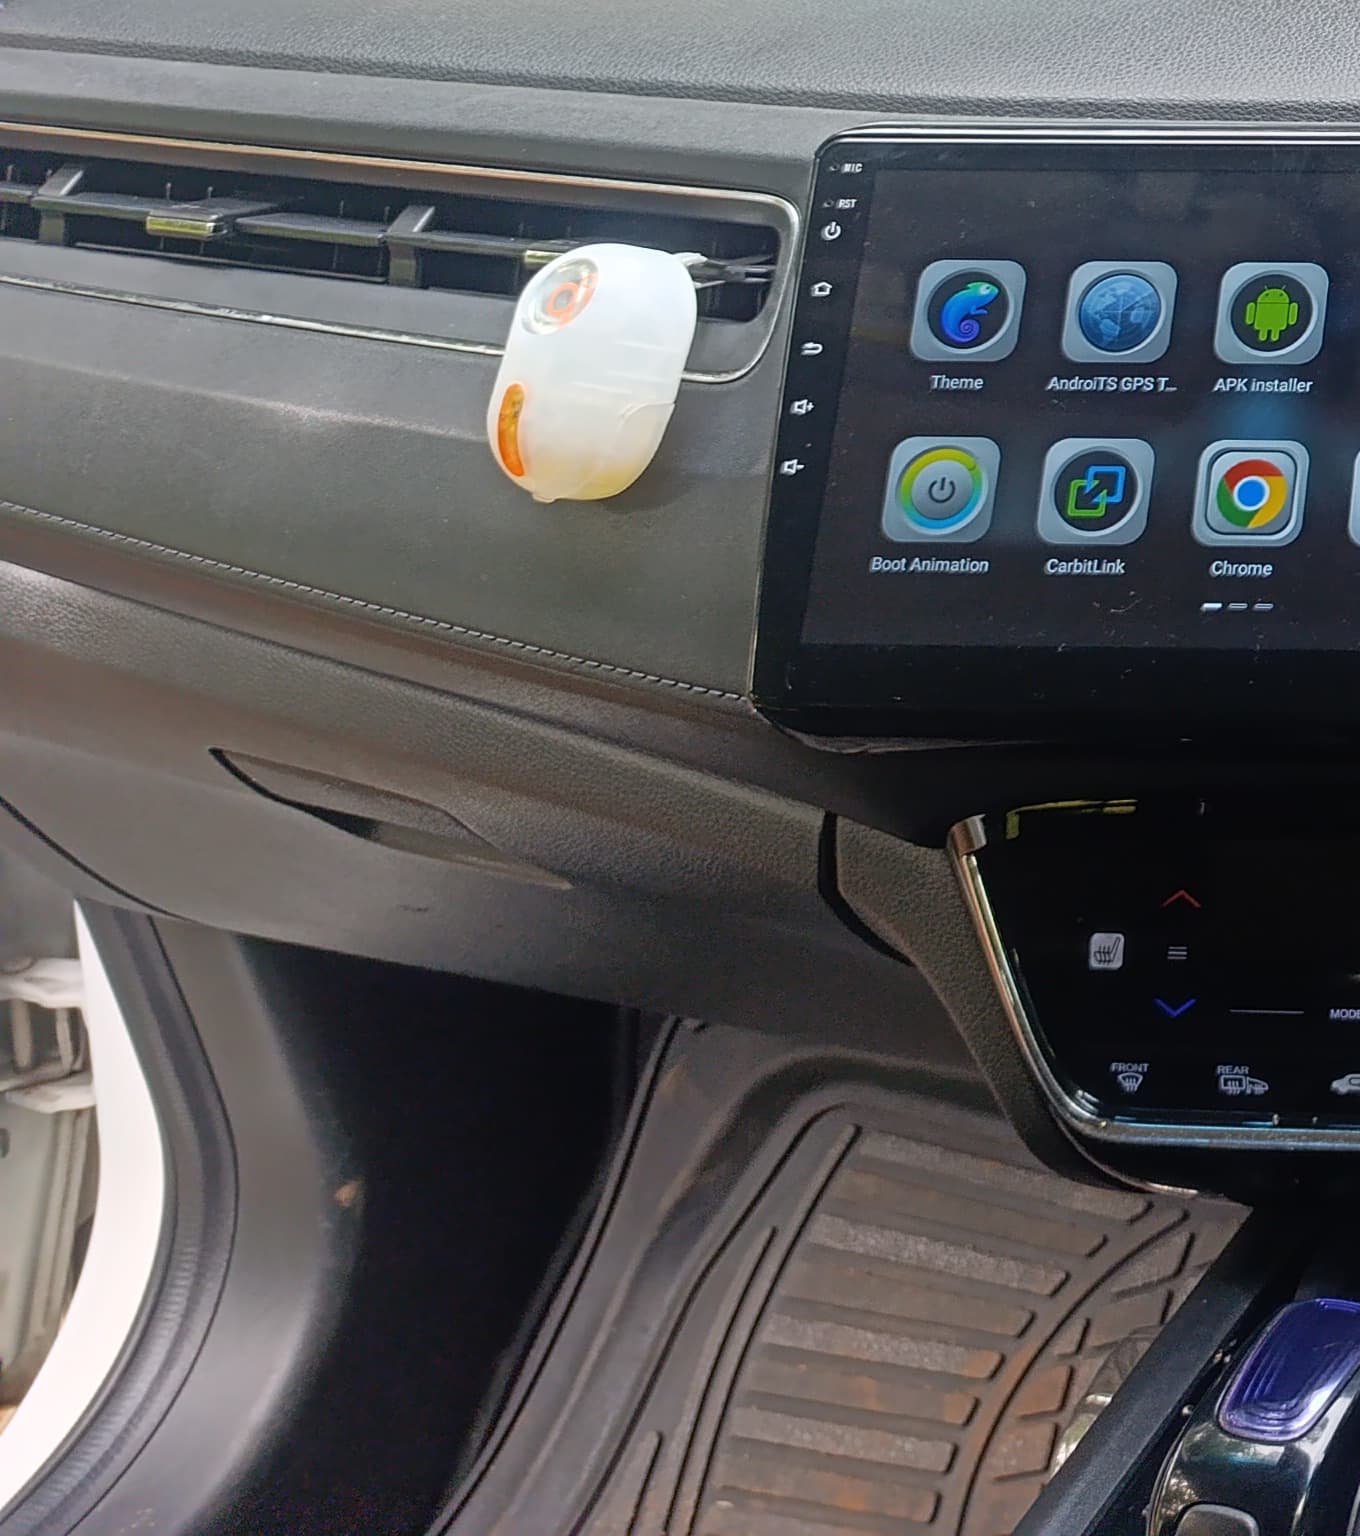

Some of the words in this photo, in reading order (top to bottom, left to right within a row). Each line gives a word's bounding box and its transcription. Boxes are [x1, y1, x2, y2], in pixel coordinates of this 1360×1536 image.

[842, 163, 863, 173] MIC
[837, 199, 857, 209] RST
[930, 374, 984, 391] Theme
[1121, 377, 1155, 391] GPS
[1212, 378, 1248, 392] APK
[1250, 378, 1313, 392] installer
[869, 556, 907, 573] Boot
[907, 557, 989, 574] Animation
[1045, 558, 1125, 575] CarbitLink
[1210, 561, 1273, 577] Chrome
[1111, 1062, 1149, 1073] FRONT
[1217, 1065, 1249, 1076] REAR
